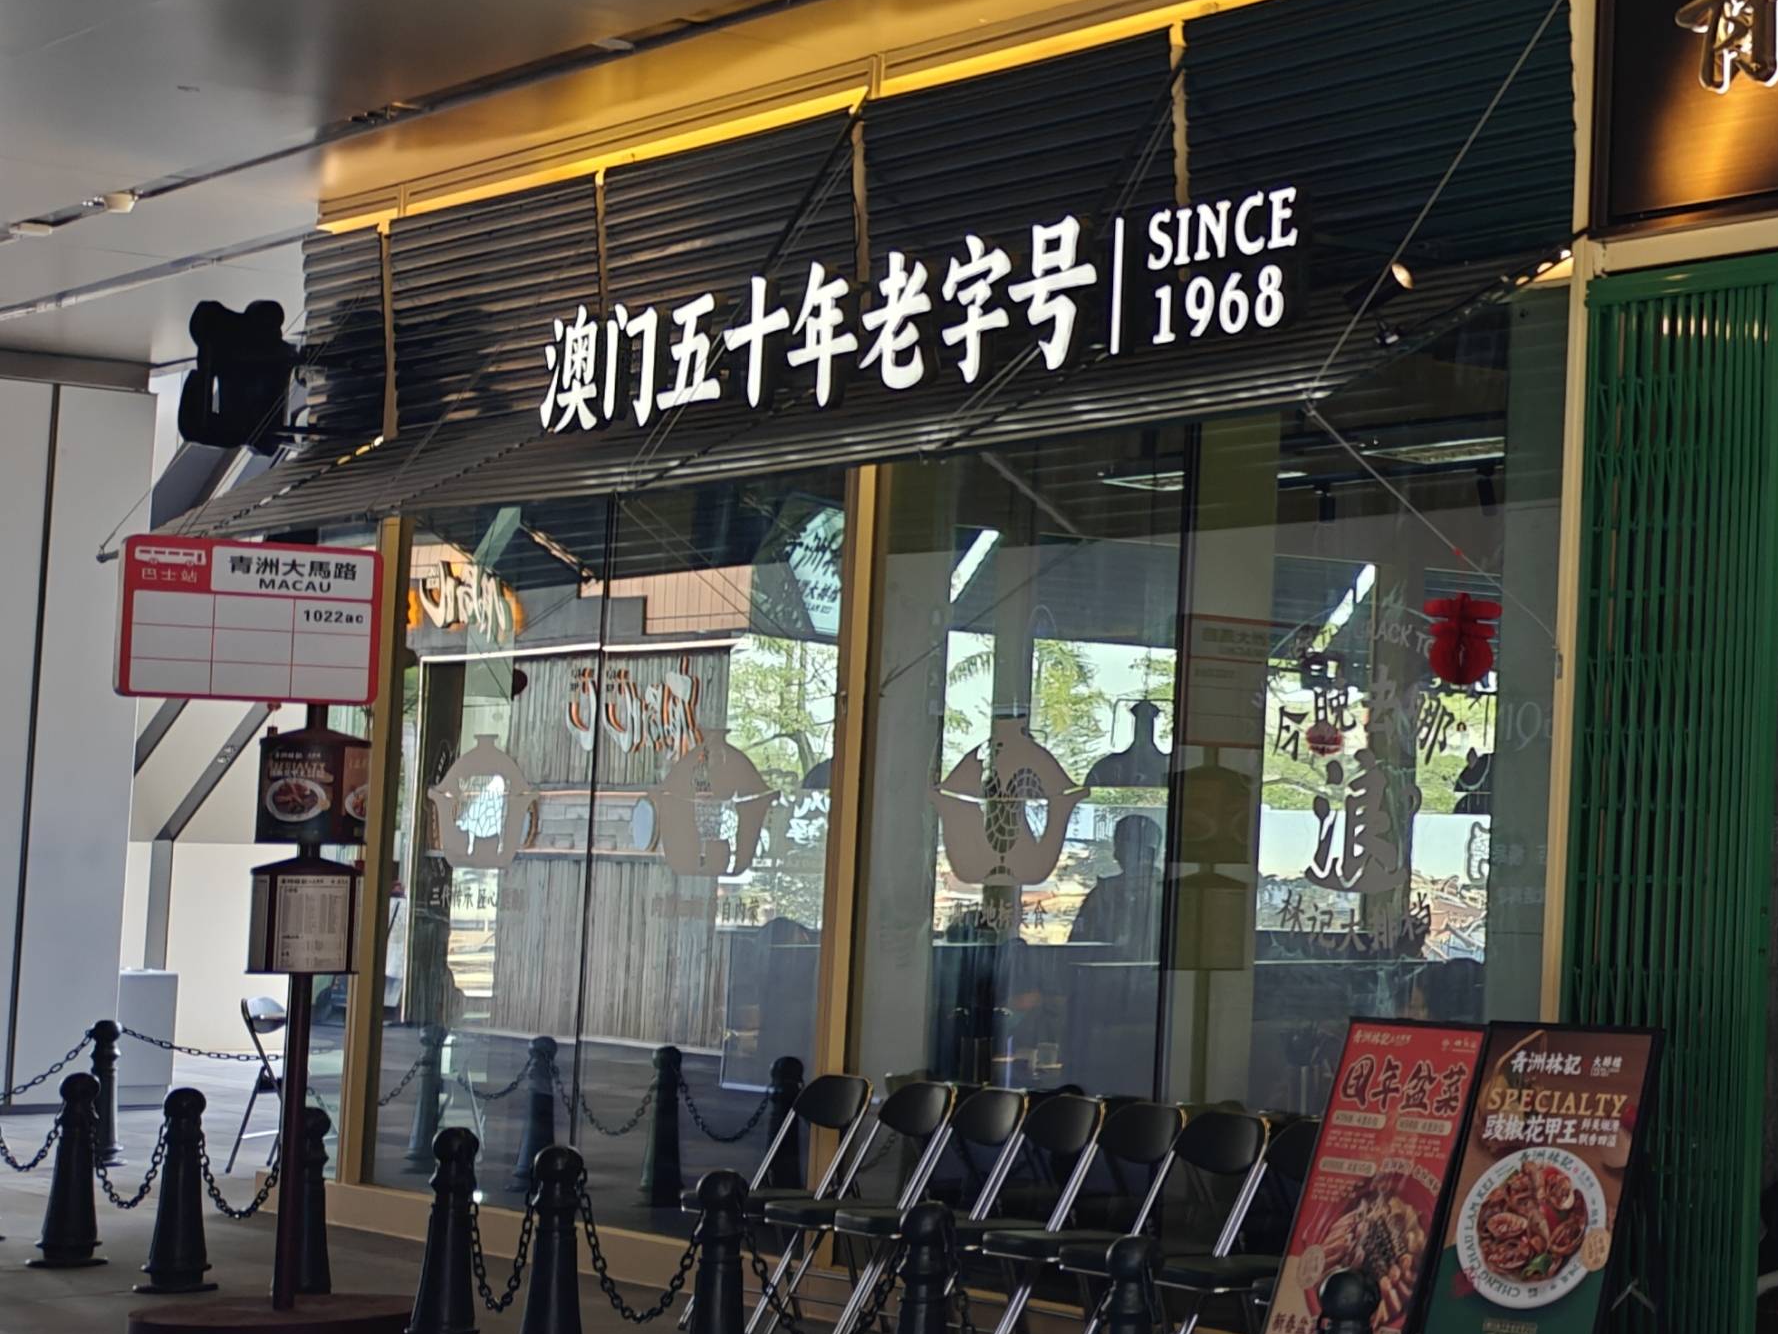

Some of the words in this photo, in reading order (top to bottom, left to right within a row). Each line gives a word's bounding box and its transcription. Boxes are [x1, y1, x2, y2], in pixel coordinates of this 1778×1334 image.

[1147, 187, 1299, 271] SINCE
[1153, 264, 1286, 345] 1968
[540, 215, 1097, 434] 澳门五十年老字号
[141, 567, 198, 583] 巴士站
[229, 555, 358, 581] 青洲大馬路
[259, 578, 332, 593] MACAU
[1487, 1088, 1628, 1118] SPECIALTY
[1482, 1113, 1578, 1145] 豉椒花甲王
